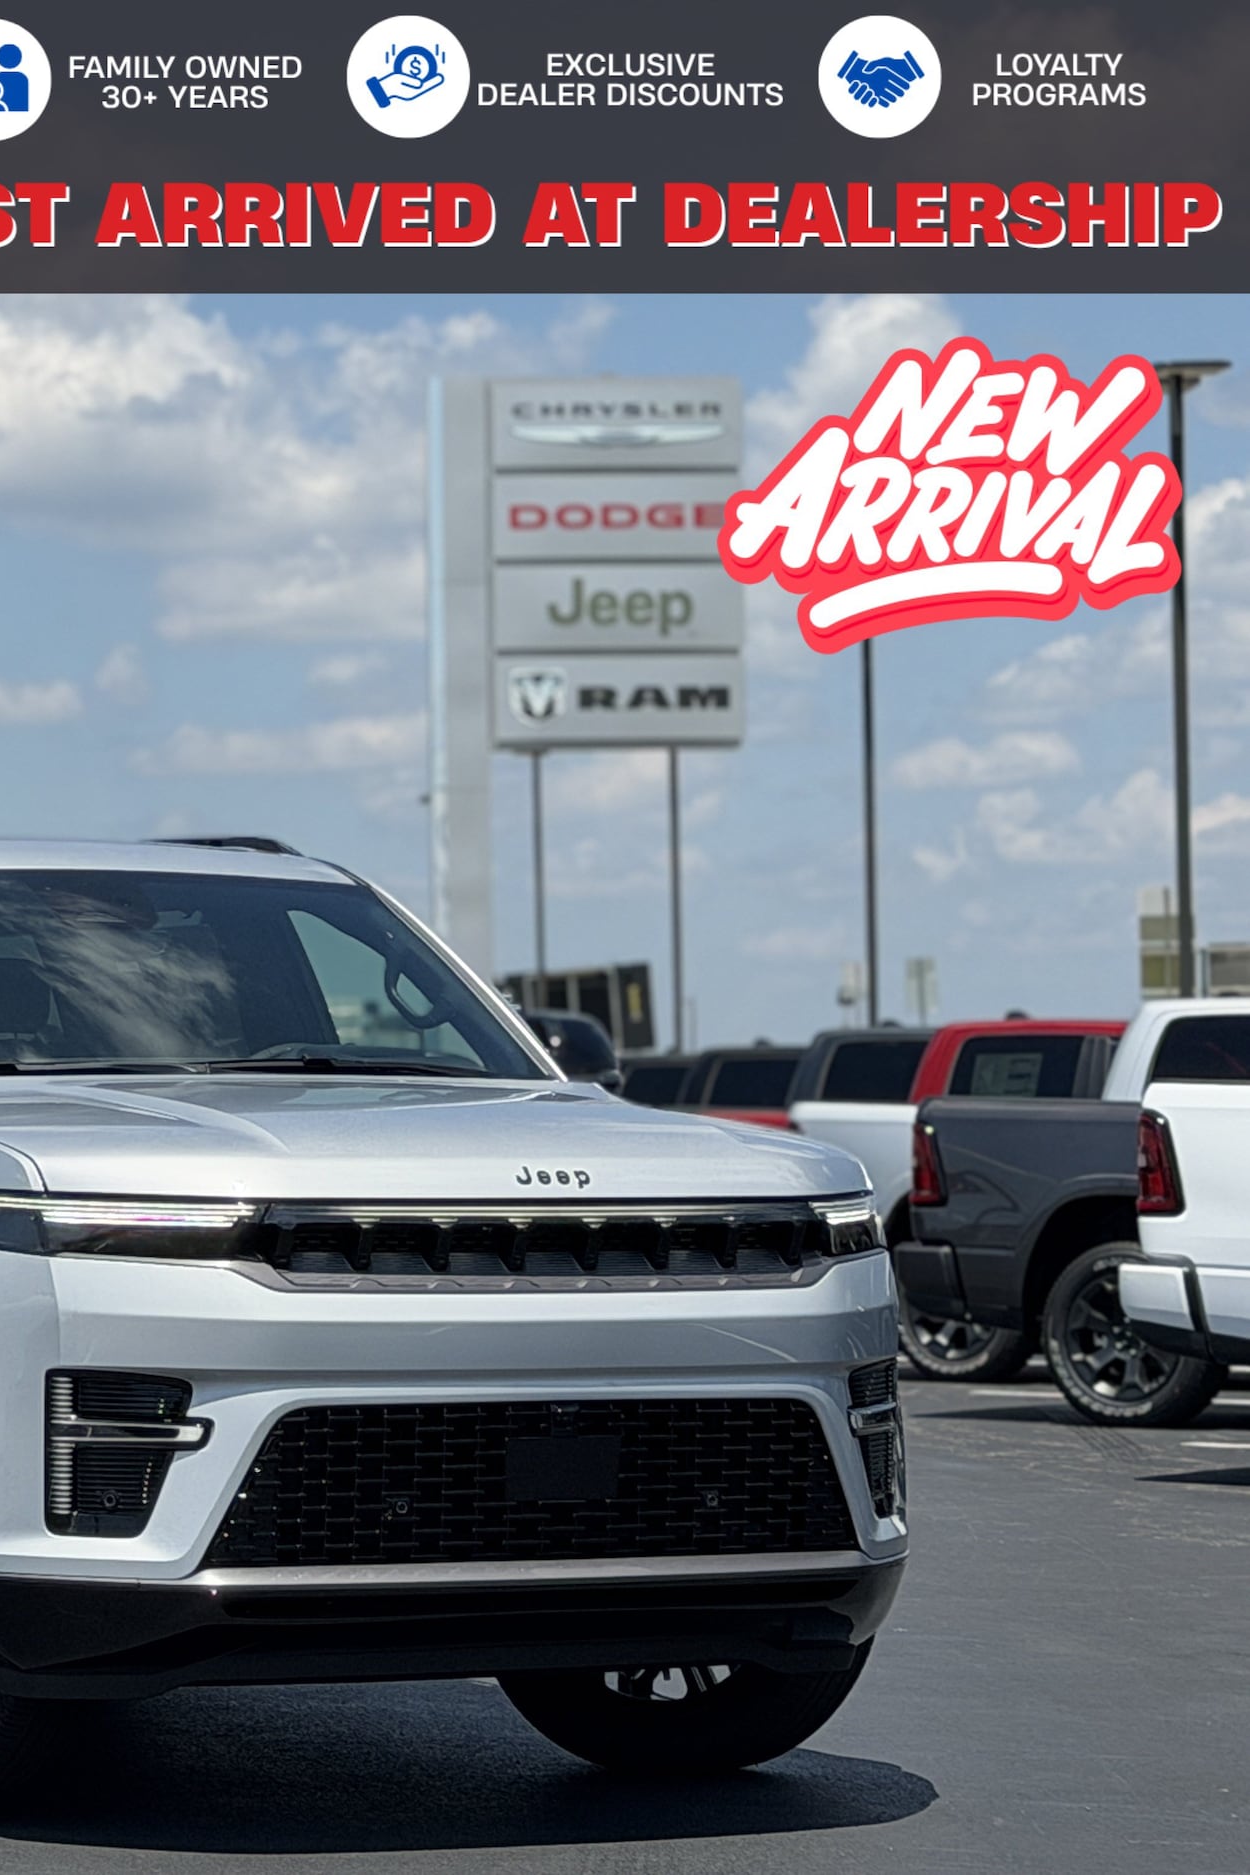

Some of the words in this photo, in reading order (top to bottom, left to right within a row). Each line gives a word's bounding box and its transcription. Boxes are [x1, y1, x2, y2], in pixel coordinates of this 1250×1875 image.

[511, 402, 722, 420] CHRYSLER
[548, 576, 694, 637] Jeep
[577, 684, 731, 711] RAM
[515, 1165, 591, 1190] Jeep
